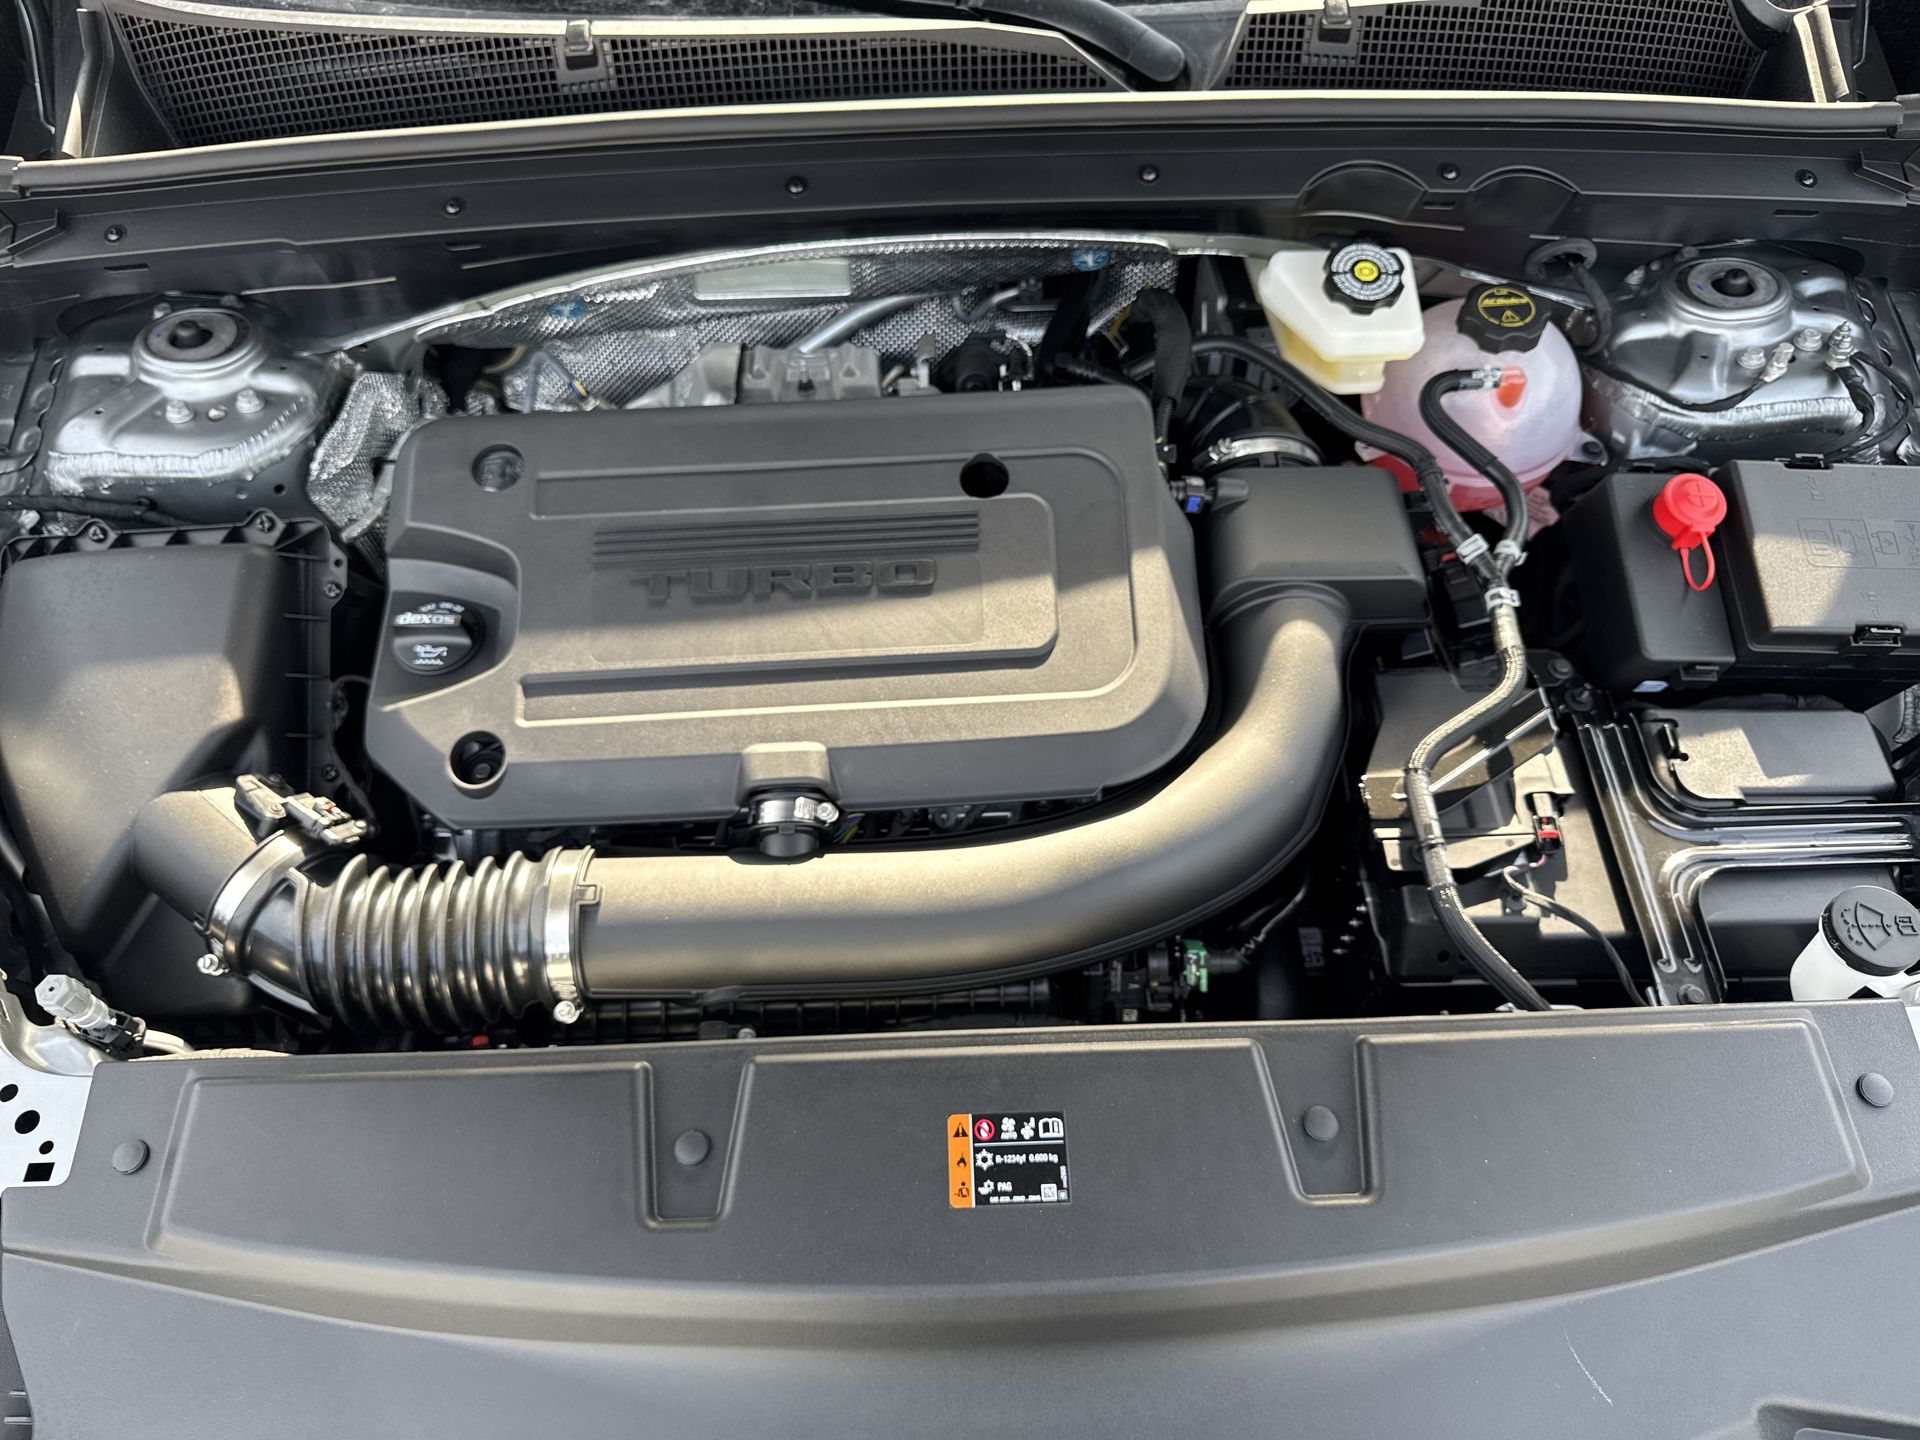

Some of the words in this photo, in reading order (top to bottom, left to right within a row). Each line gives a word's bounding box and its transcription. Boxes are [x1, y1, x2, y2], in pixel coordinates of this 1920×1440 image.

[630, 559, 936, 604] TURBO
[396, 611, 455, 625] dexos
[1049, 1153, 1058, 1163] kg
[997, 1182, 1012, 1192] PAG
